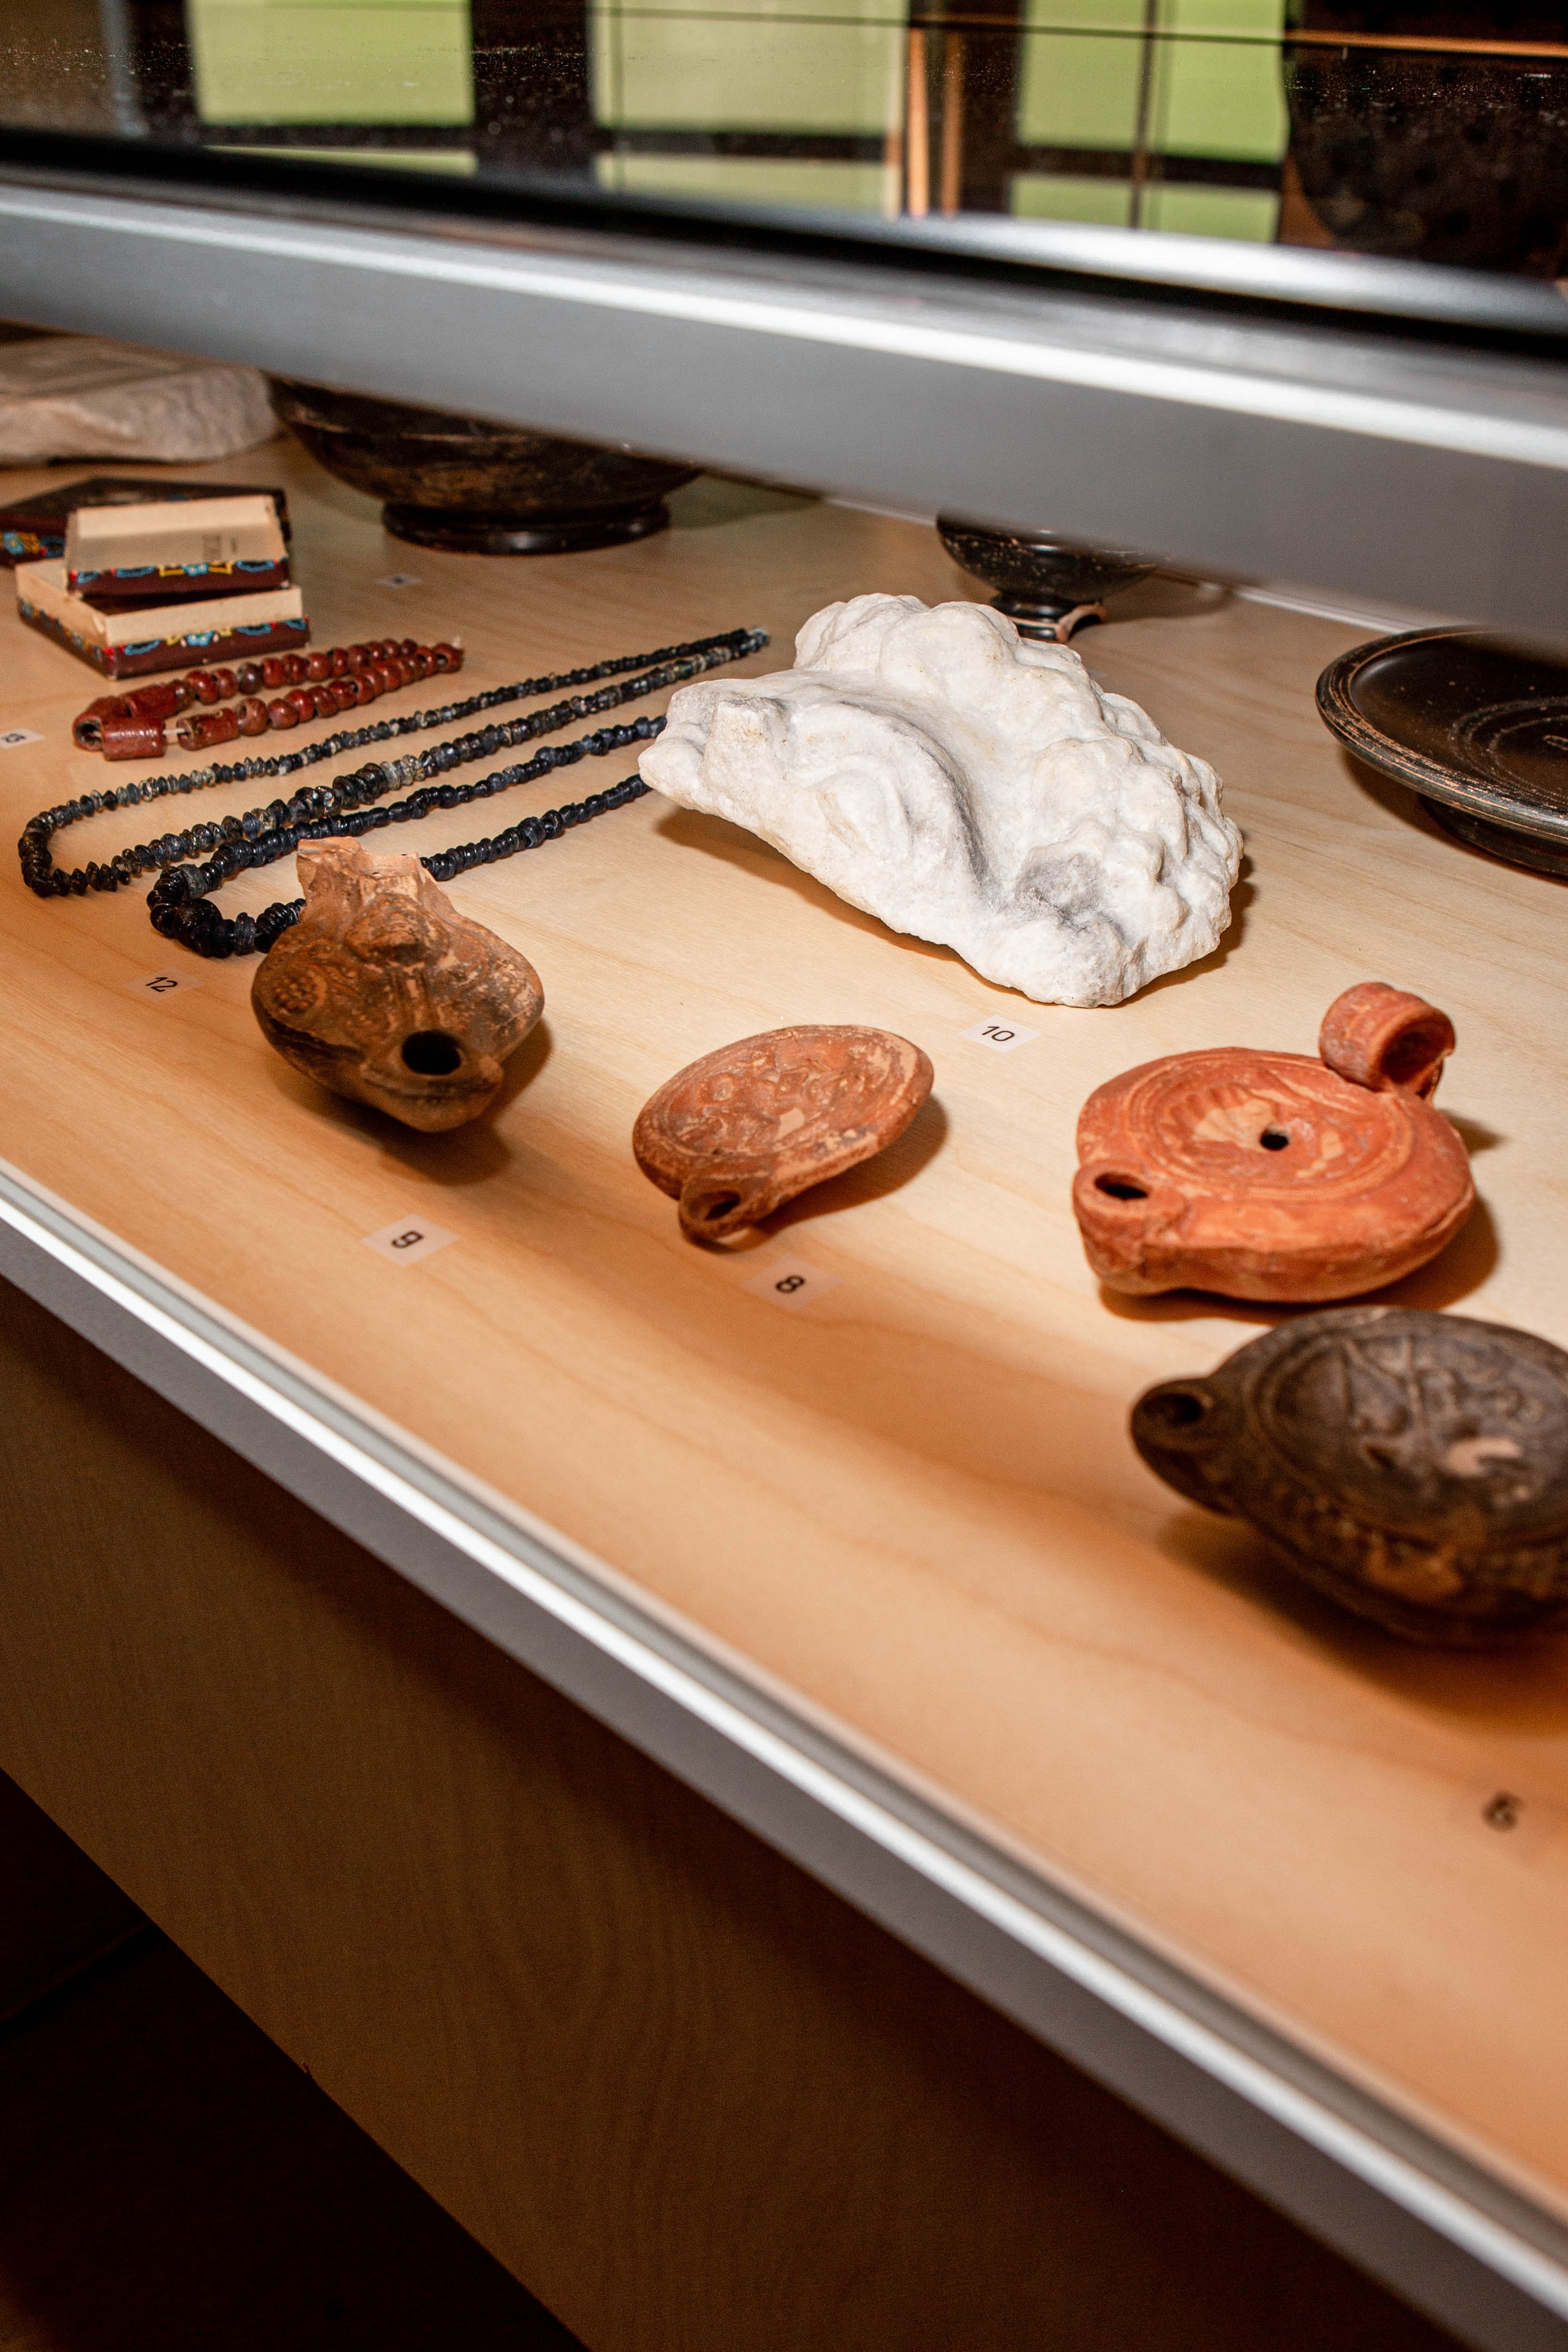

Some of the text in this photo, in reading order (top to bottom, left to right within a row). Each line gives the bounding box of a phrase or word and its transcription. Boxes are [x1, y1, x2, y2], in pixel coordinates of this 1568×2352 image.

[145, 976, 178, 993] 12
[981, 1026, 1016, 1042] 10
[391, 1231, 423, 1248] 9
[775, 1275, 805, 1294] 8
